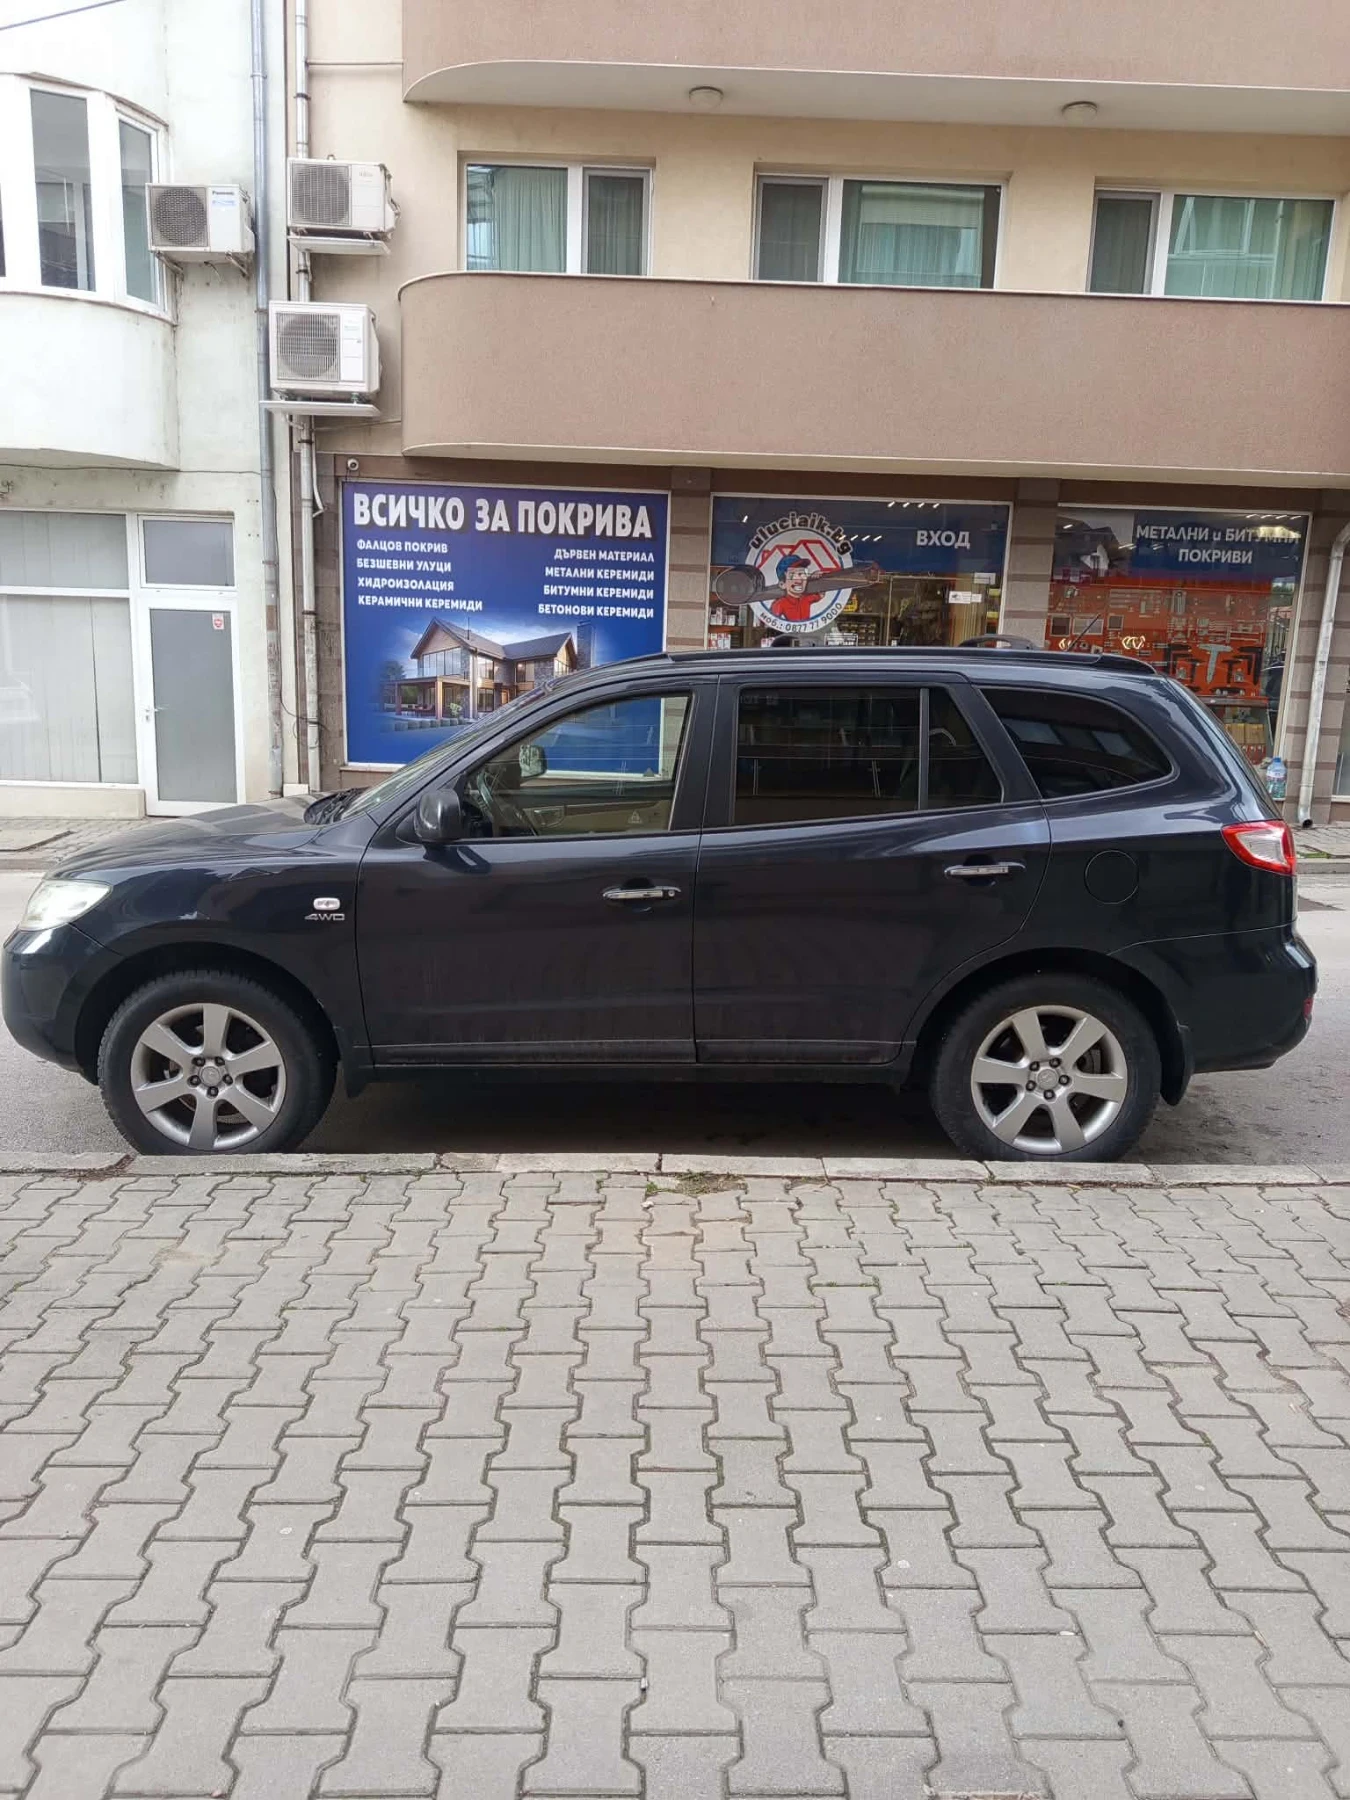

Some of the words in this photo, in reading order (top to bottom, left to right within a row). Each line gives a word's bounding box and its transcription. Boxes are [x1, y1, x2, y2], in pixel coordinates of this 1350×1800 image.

[354, 493, 465, 530] ВСИЧКО
[475, 498, 511, 532] ЗА
[518, 500, 652, 538] ПОКРИВА
[916, 530, 971, 550] ВХОД
[1136, 525, 1209, 541] МЕТАЛНИ
[1213, 532, 1221, 541] и
[357, 539, 402, 552] ФАЛЦОВ
[404, 541, 448, 553] ПОКРИВ
[554, 548, 596, 560] ДЪРВЕН
[598, 551, 654, 562] МАТЕРИАЛ
[1178, 548, 1253, 564] ПОКРИВИ
[357, 558, 414, 570] БЕЗШЕВНИ
[416, 560, 451, 573] УЛУЦИ
[545, 567, 594, 578] МЕТАЛНИ
[597, 569, 654, 582] КЕРЕМИДИ
[358, 577, 454, 592] ХИДРОИЗОЛАЦИЯ
[543, 585, 594, 597] БИТУМНИ
[596, 587, 654, 600] КЕРЕМИДИ
[358, 595, 423, 608] КЕРАМИЧНИ
[425, 598, 483, 612] КЕРЕМИДИ
[538, 603, 594, 616] БЕТОНОВИ
[596, 606, 654, 619] КЕРЕМИДИ
[821, 602, 842, 624] 9000
[304, 913, 345, 921] 4WD
